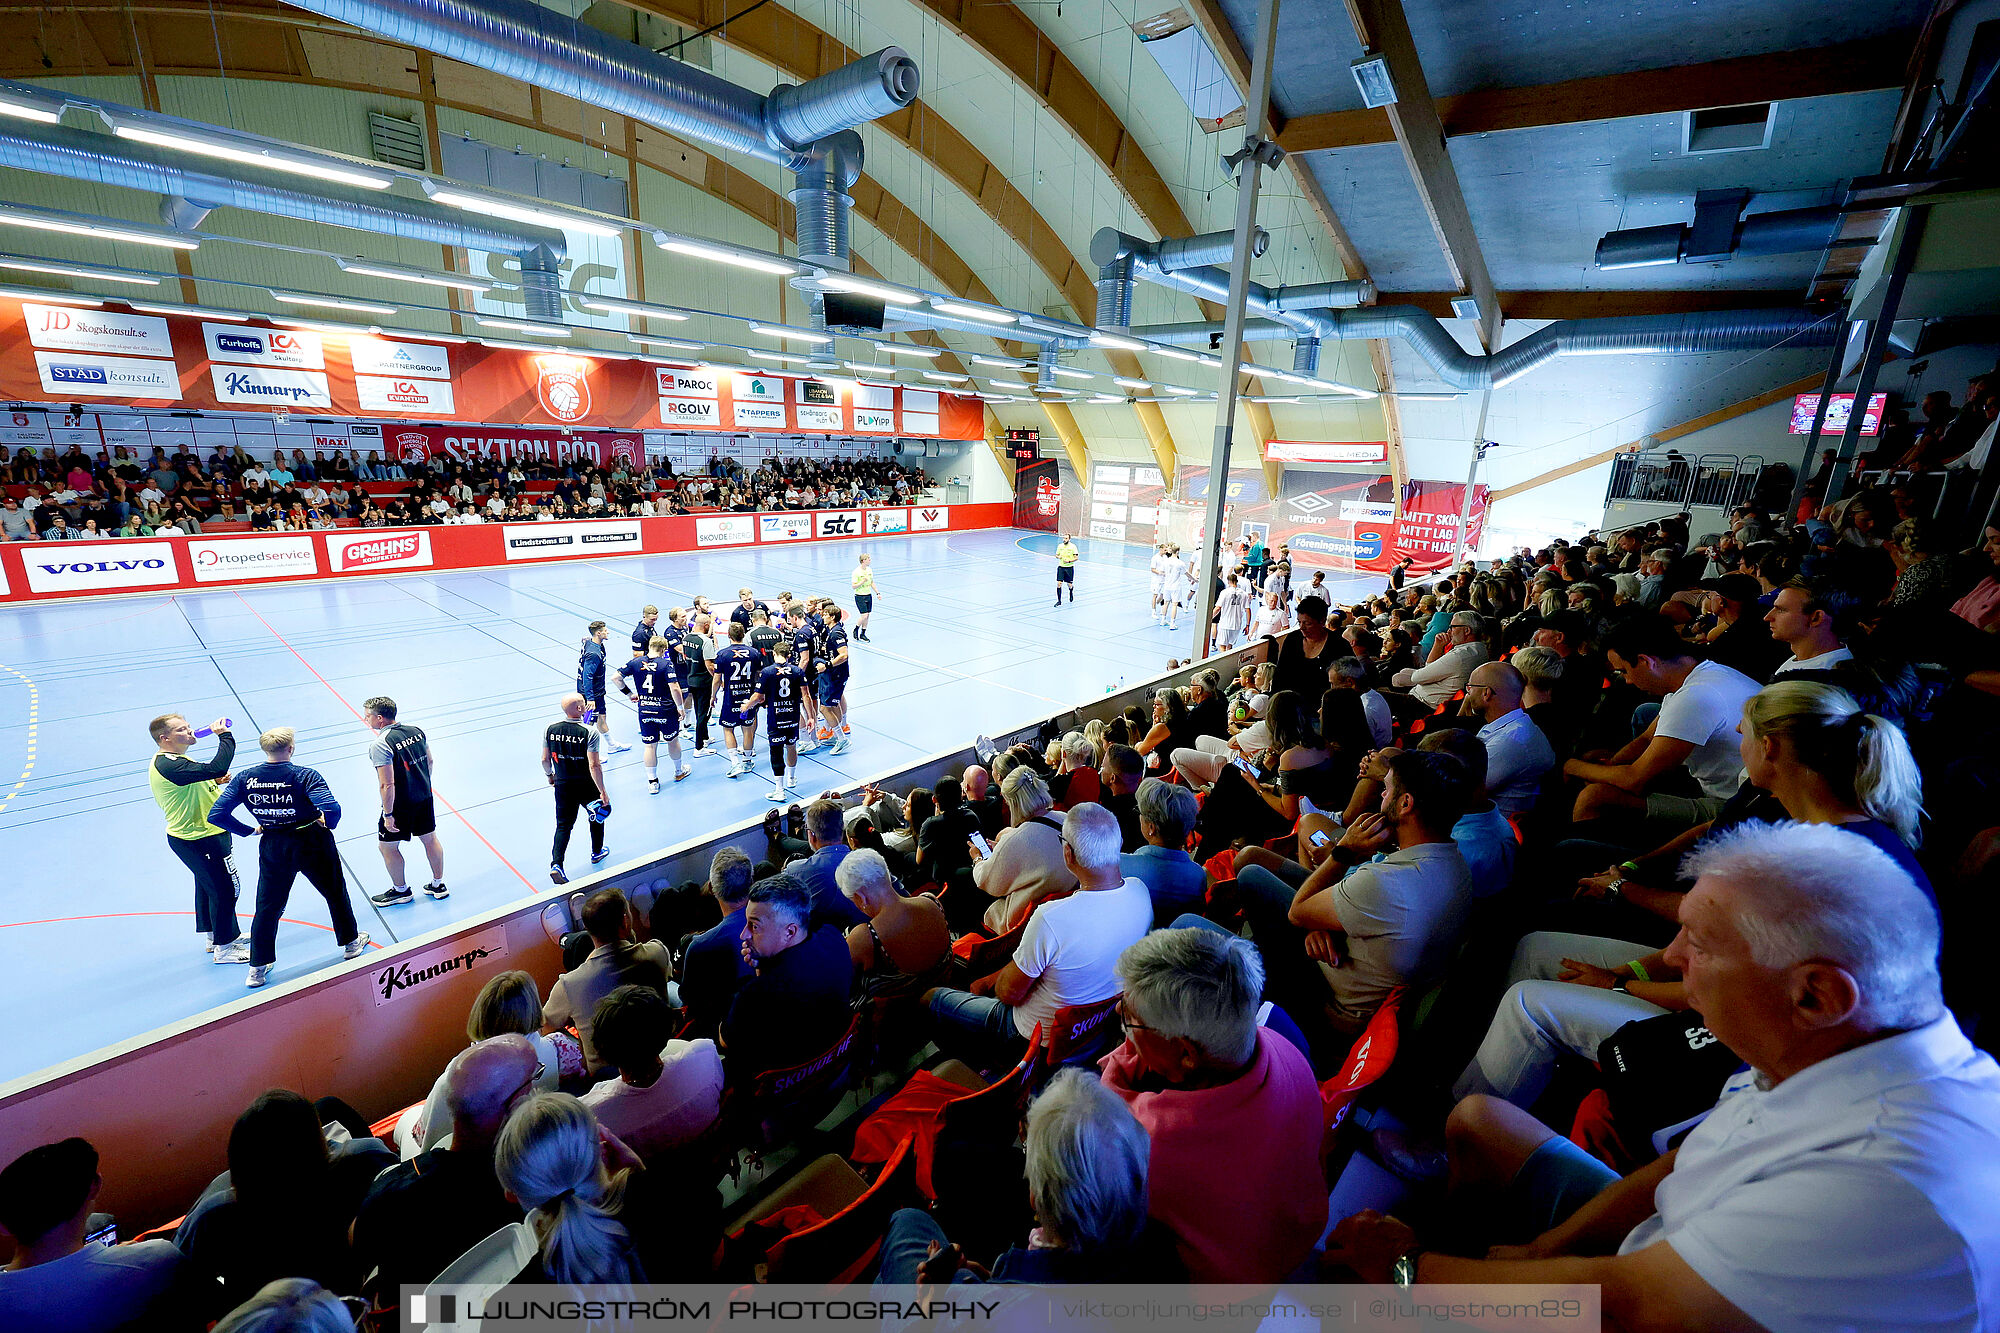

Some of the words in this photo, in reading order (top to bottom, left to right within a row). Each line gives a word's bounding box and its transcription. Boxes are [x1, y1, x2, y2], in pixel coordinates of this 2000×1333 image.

[41, 311, 70, 331] JD
[76, 321, 147, 338] Skogskonsult.se
[220, 338, 261, 349] Furhoffs
[268, 333, 301, 349] ICA
[274, 355, 303, 363] Skultorp
[379, 361, 442, 372] PARTNERGROUP
[54, 367, 103, 380] STÄD
[109, 370, 165, 383] konsult.
[225, 372, 312, 400] Kinnarps
[393, 381, 419, 394] ICA
[678, 379, 712, 390] PAROC
[388, 394, 428, 403] KVANTUM
[746, 409, 781, 417] TAPPERS
[316, 437, 348, 446] MAXI
[1347, 507, 1393, 517] INTERSPORT
[1403, 510, 1435, 523] MITT
[783, 518, 809, 528] zerva
[1289, 514, 1326, 525] umbro
[585, 534, 624, 543] Lindströms
[624, 533, 633, 541] Bil
[1400, 524, 1433, 538] MITT
[1433, 527, 1454, 540] LAG
[515, 536, 557, 547] Lindströms
[558, 536, 569, 544] Bil
[1295, 535, 1375, 555] Föreningspapper
[1397, 536, 1430, 551] MITT
[347, 537, 417, 561] GRAHNS
[198, 549, 311, 565] Ortopedservice
[37, 559, 165, 574] VOLVO
[756, 633, 780, 641] BRIXLY
[730, 660, 752, 681] 24
[642, 674, 655, 694] 4
[778, 677, 791, 698] 8
[396, 733, 424, 751] BRIXLY
[550, 733, 585, 744] BRIXLY
[246, 777, 286, 790] Kinnarps
[247, 792, 293, 806] PRIMA
[379, 945, 502, 999] Kinnarps
